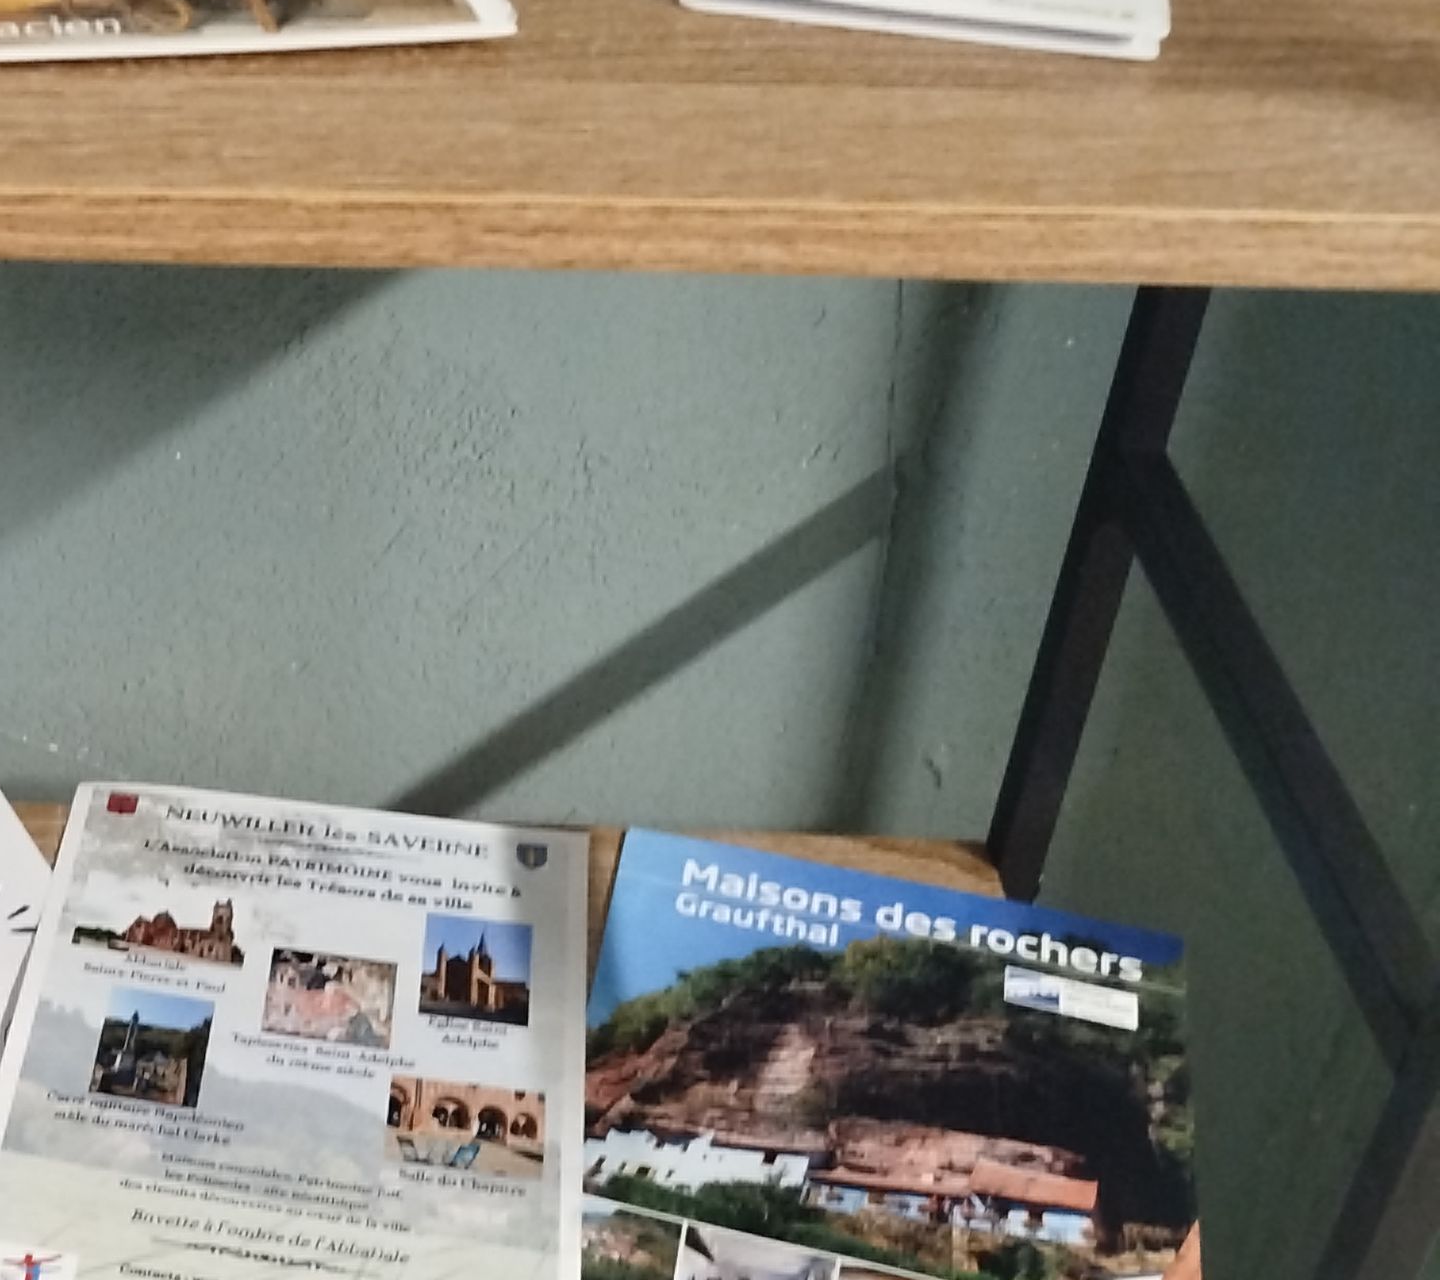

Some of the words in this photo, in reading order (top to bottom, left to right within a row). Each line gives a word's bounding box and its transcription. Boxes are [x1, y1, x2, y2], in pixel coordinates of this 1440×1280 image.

[166, 804, 314, 837] NEUWILLER
[368, 830, 490, 860] SAVERNE
[267, 852, 394, 882] PATRIMOINE
[398, 873, 443, 888] vous
[380, 888, 404, 902] de
[433, 895, 474, 911] ville
[673, 892, 841, 948] Graufthal
[680, 858, 863, 924] Maisons
[874, 900, 958, 943] des
[968, 923, 1144, 983] rochers
